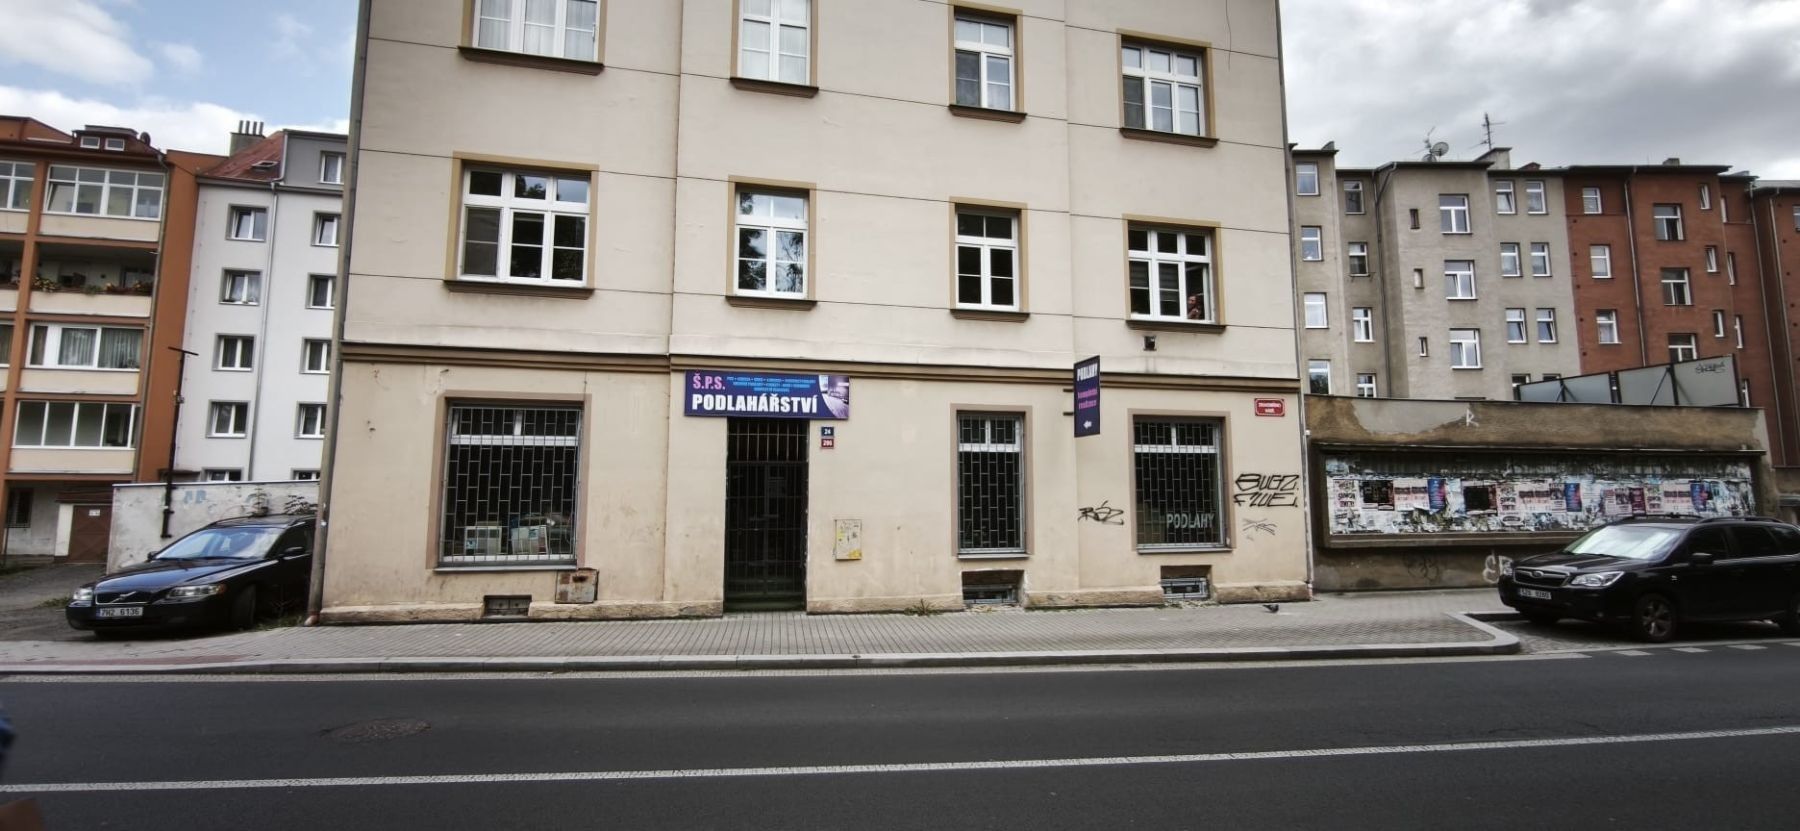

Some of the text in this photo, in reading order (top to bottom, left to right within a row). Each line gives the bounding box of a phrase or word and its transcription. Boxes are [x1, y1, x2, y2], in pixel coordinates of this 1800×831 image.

[692, 373, 726, 390] Š.P.S.
[691, 392, 818, 414] PODLAHÁŘSTVÍ
[1166, 513, 1215, 529] PODLAHY
